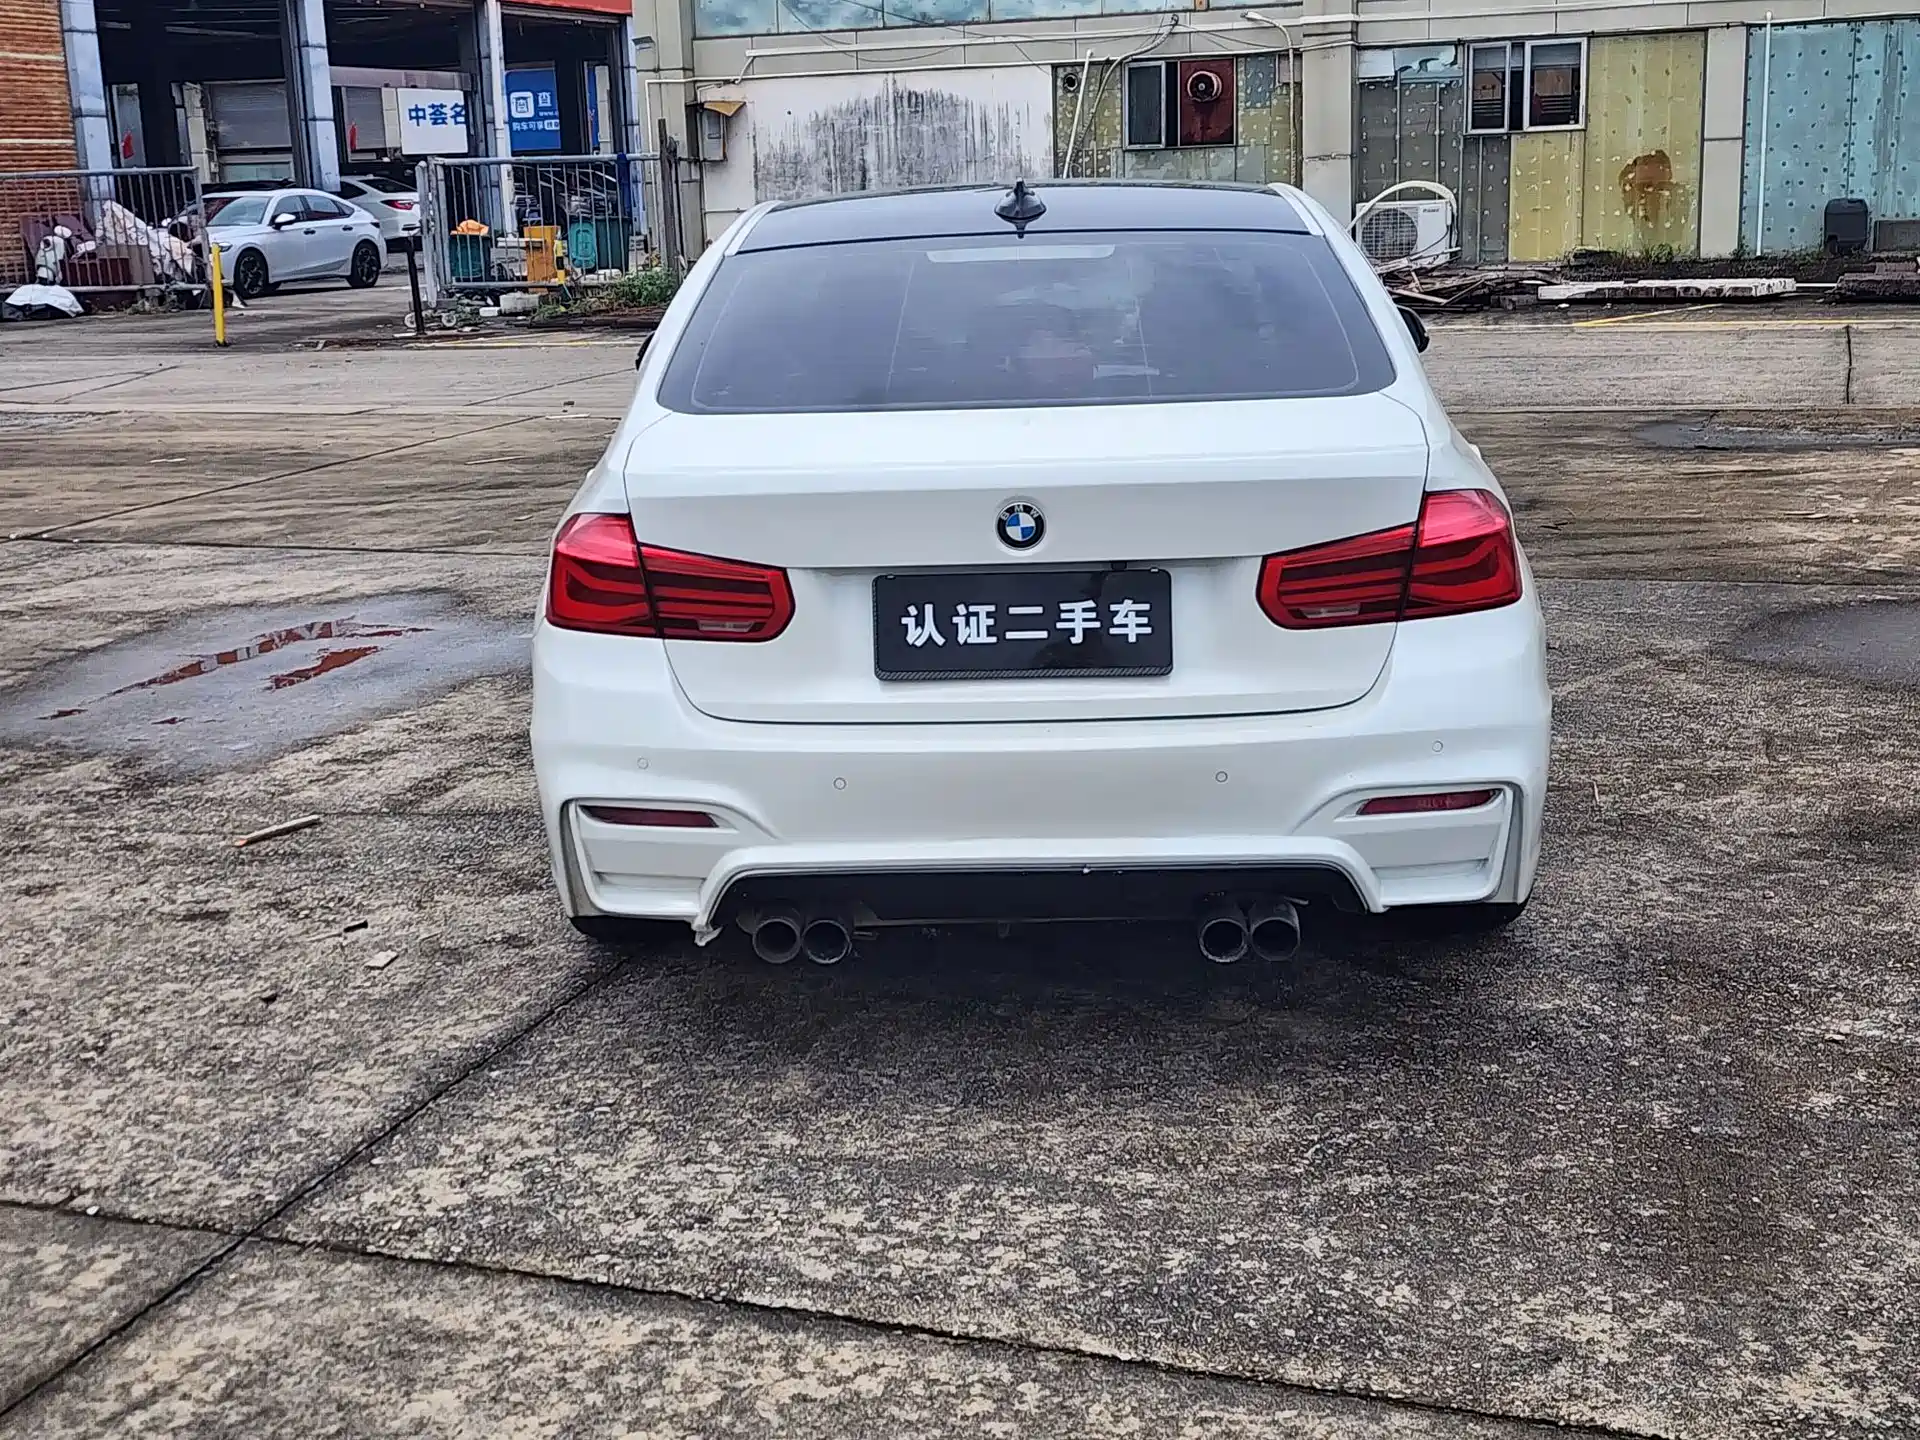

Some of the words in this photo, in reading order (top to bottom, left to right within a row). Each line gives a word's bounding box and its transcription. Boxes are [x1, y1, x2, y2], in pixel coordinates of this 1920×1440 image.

[408, 103, 466, 126] 中荟名
[1000, 504, 1039, 520] BMW
[901, 599, 1153, 647] 认证二手车
